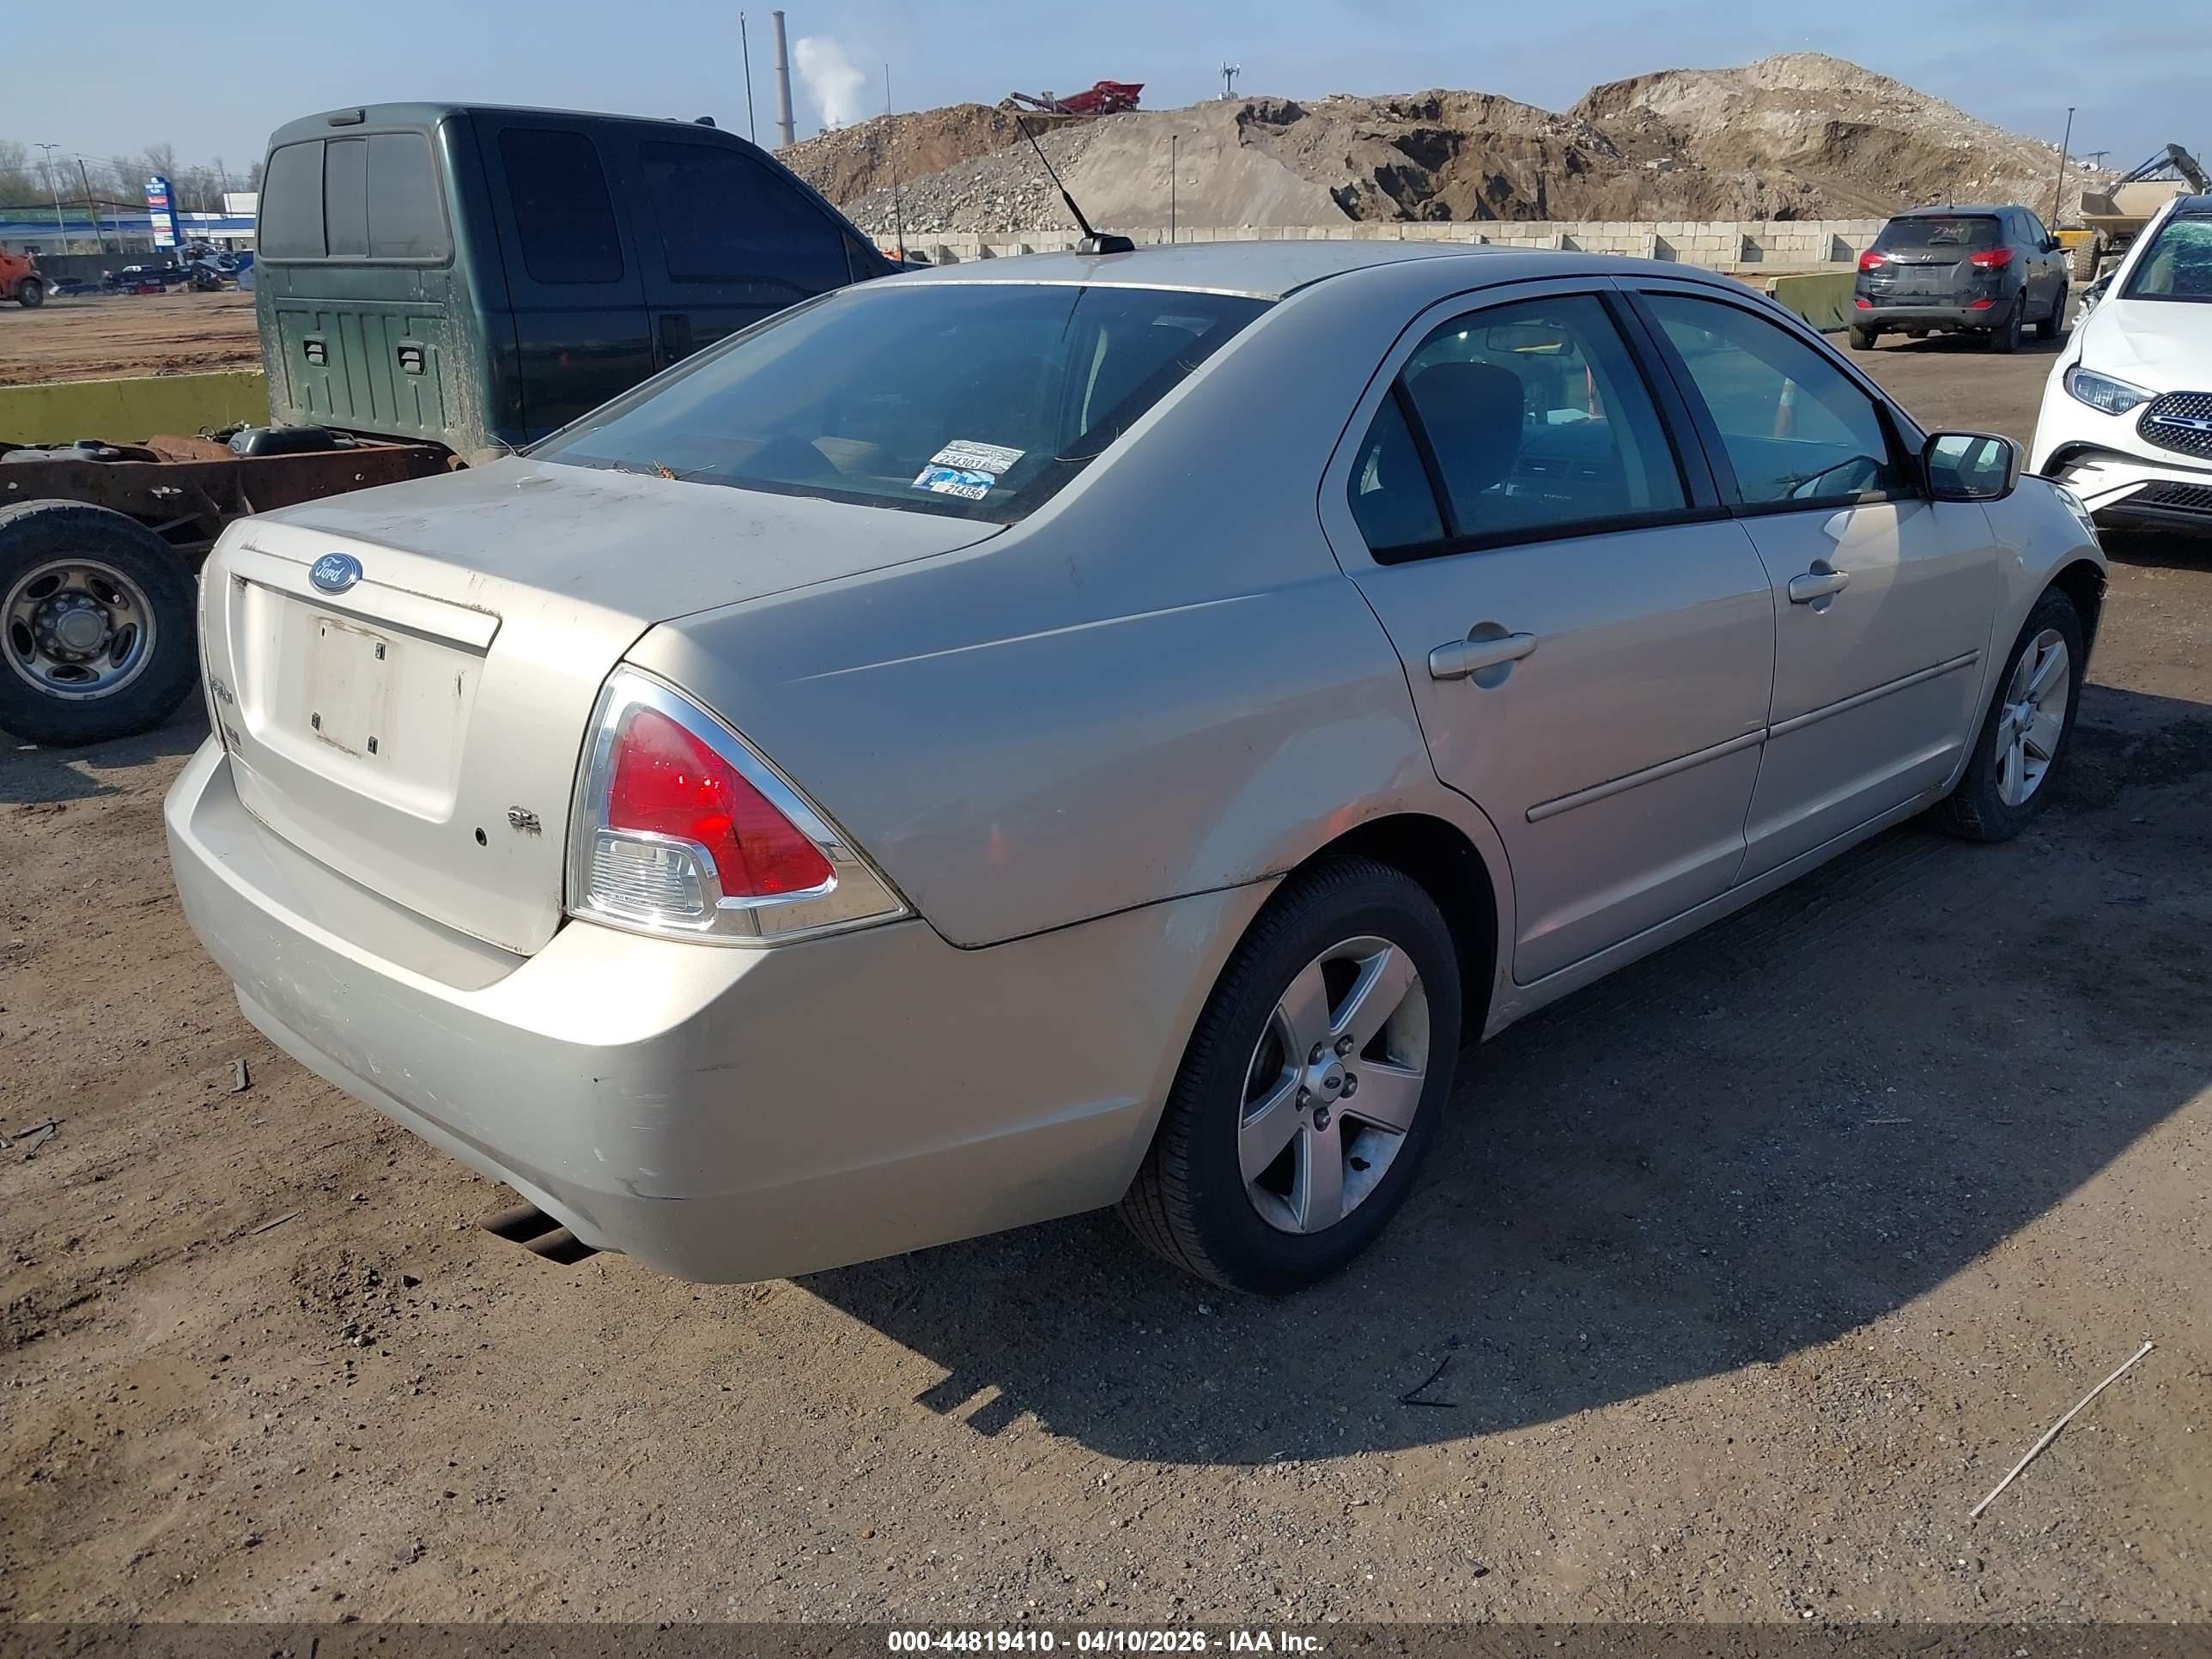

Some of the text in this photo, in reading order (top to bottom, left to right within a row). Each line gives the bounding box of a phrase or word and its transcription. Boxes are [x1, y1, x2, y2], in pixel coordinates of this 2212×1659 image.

[939, 454, 981, 469] 224303
[945, 484, 983, 499] 214356
[315, 556, 345, 582] Ford
